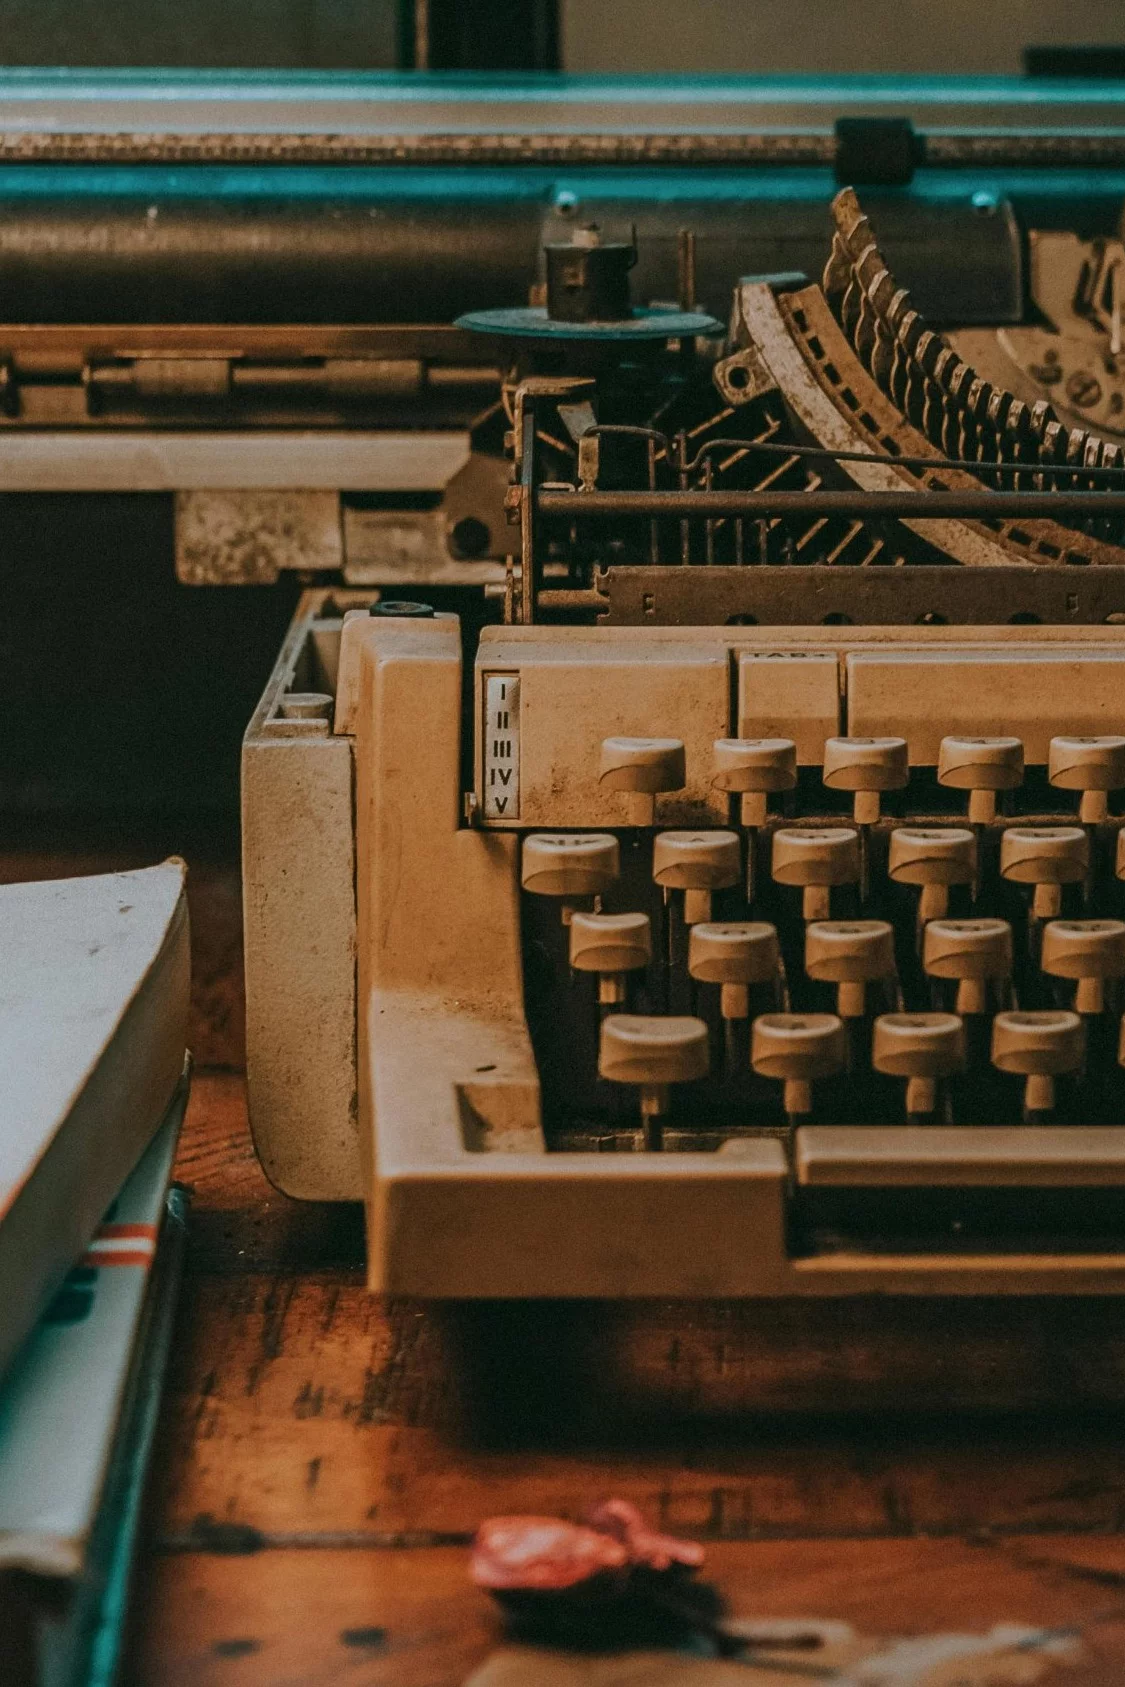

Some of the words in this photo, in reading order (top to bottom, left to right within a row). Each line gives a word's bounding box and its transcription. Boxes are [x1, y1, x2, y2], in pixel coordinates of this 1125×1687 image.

[501, 683, 506, 700] I
[497, 711, 509, 729] II
[493, 740, 512, 758] III
[490, 768, 513, 786] IV
[495, 797, 508, 814] V
